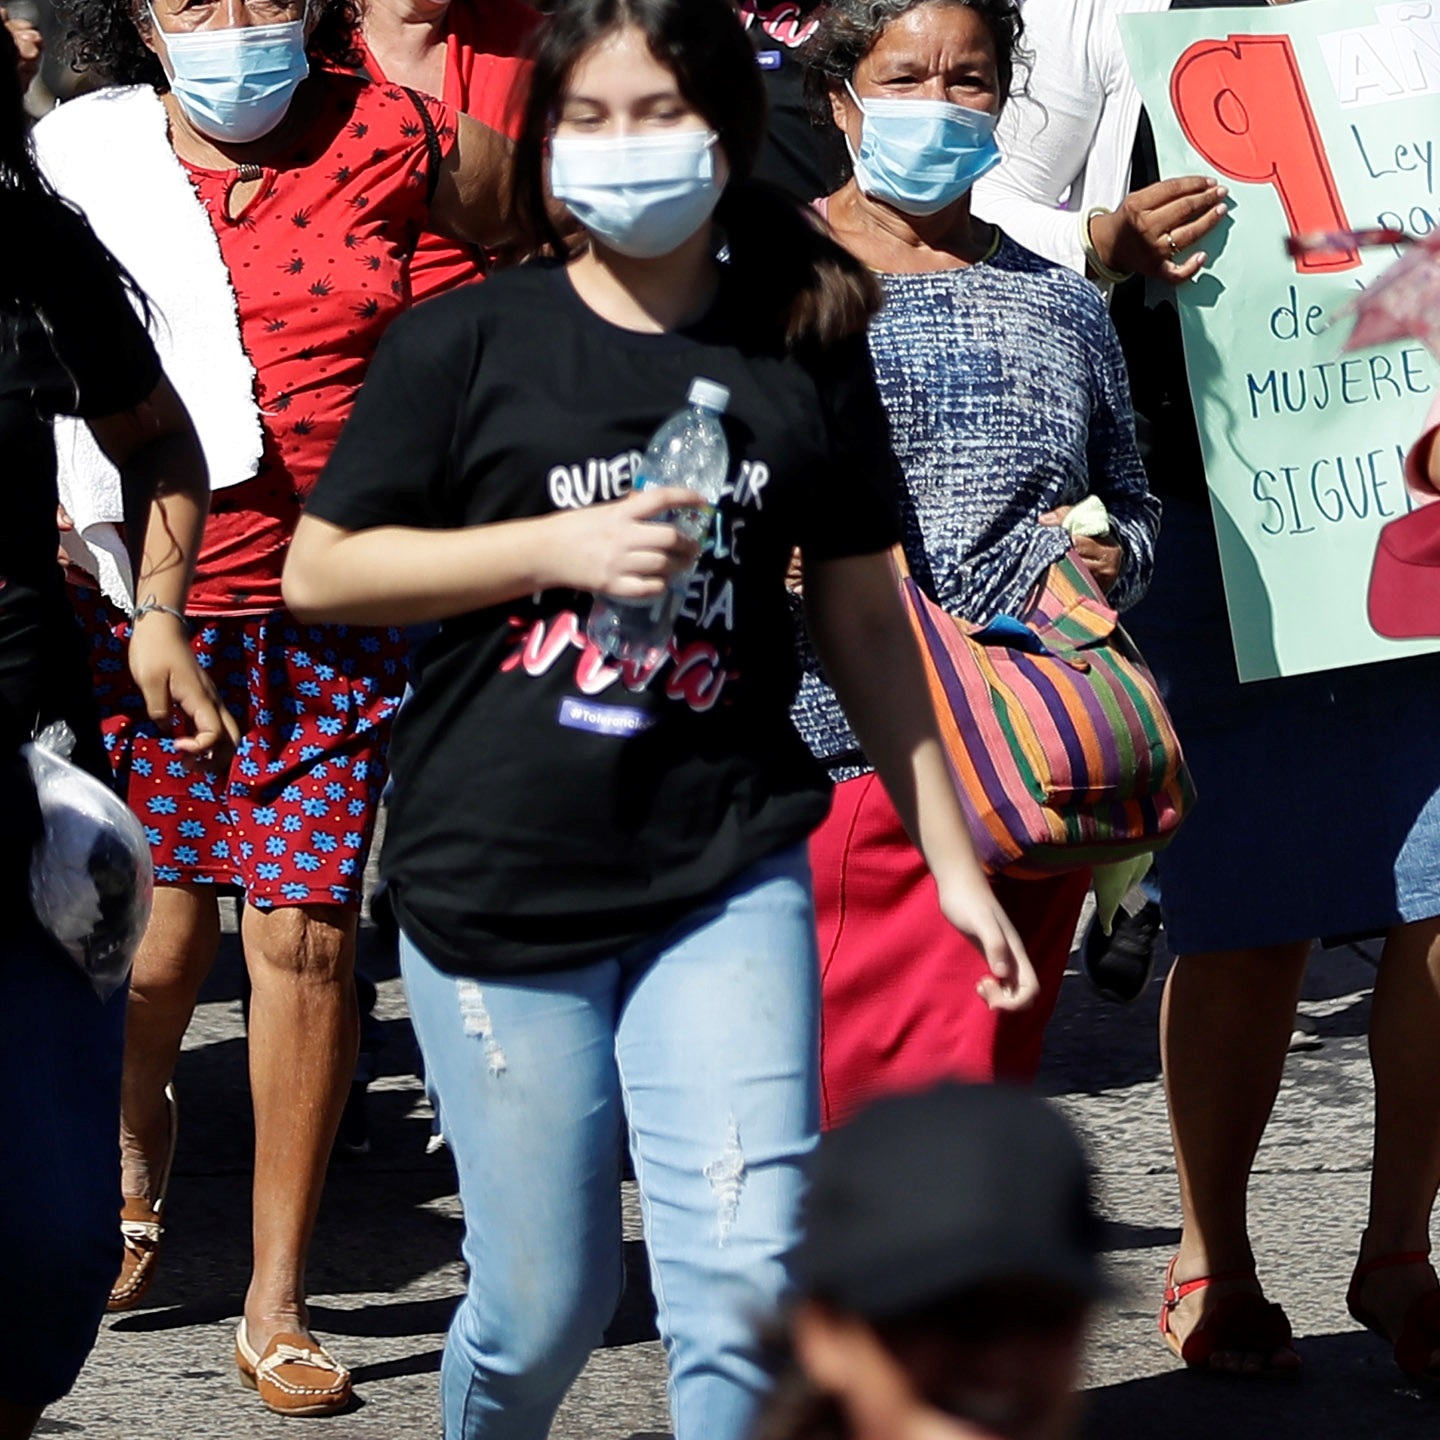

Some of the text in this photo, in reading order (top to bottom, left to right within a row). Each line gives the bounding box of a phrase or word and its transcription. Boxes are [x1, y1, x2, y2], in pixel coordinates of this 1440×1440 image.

[1350, 123, 1433, 194] Ley
[1270, 285, 1328, 340] de
[1246, 347, 1431, 419] MUJERE
